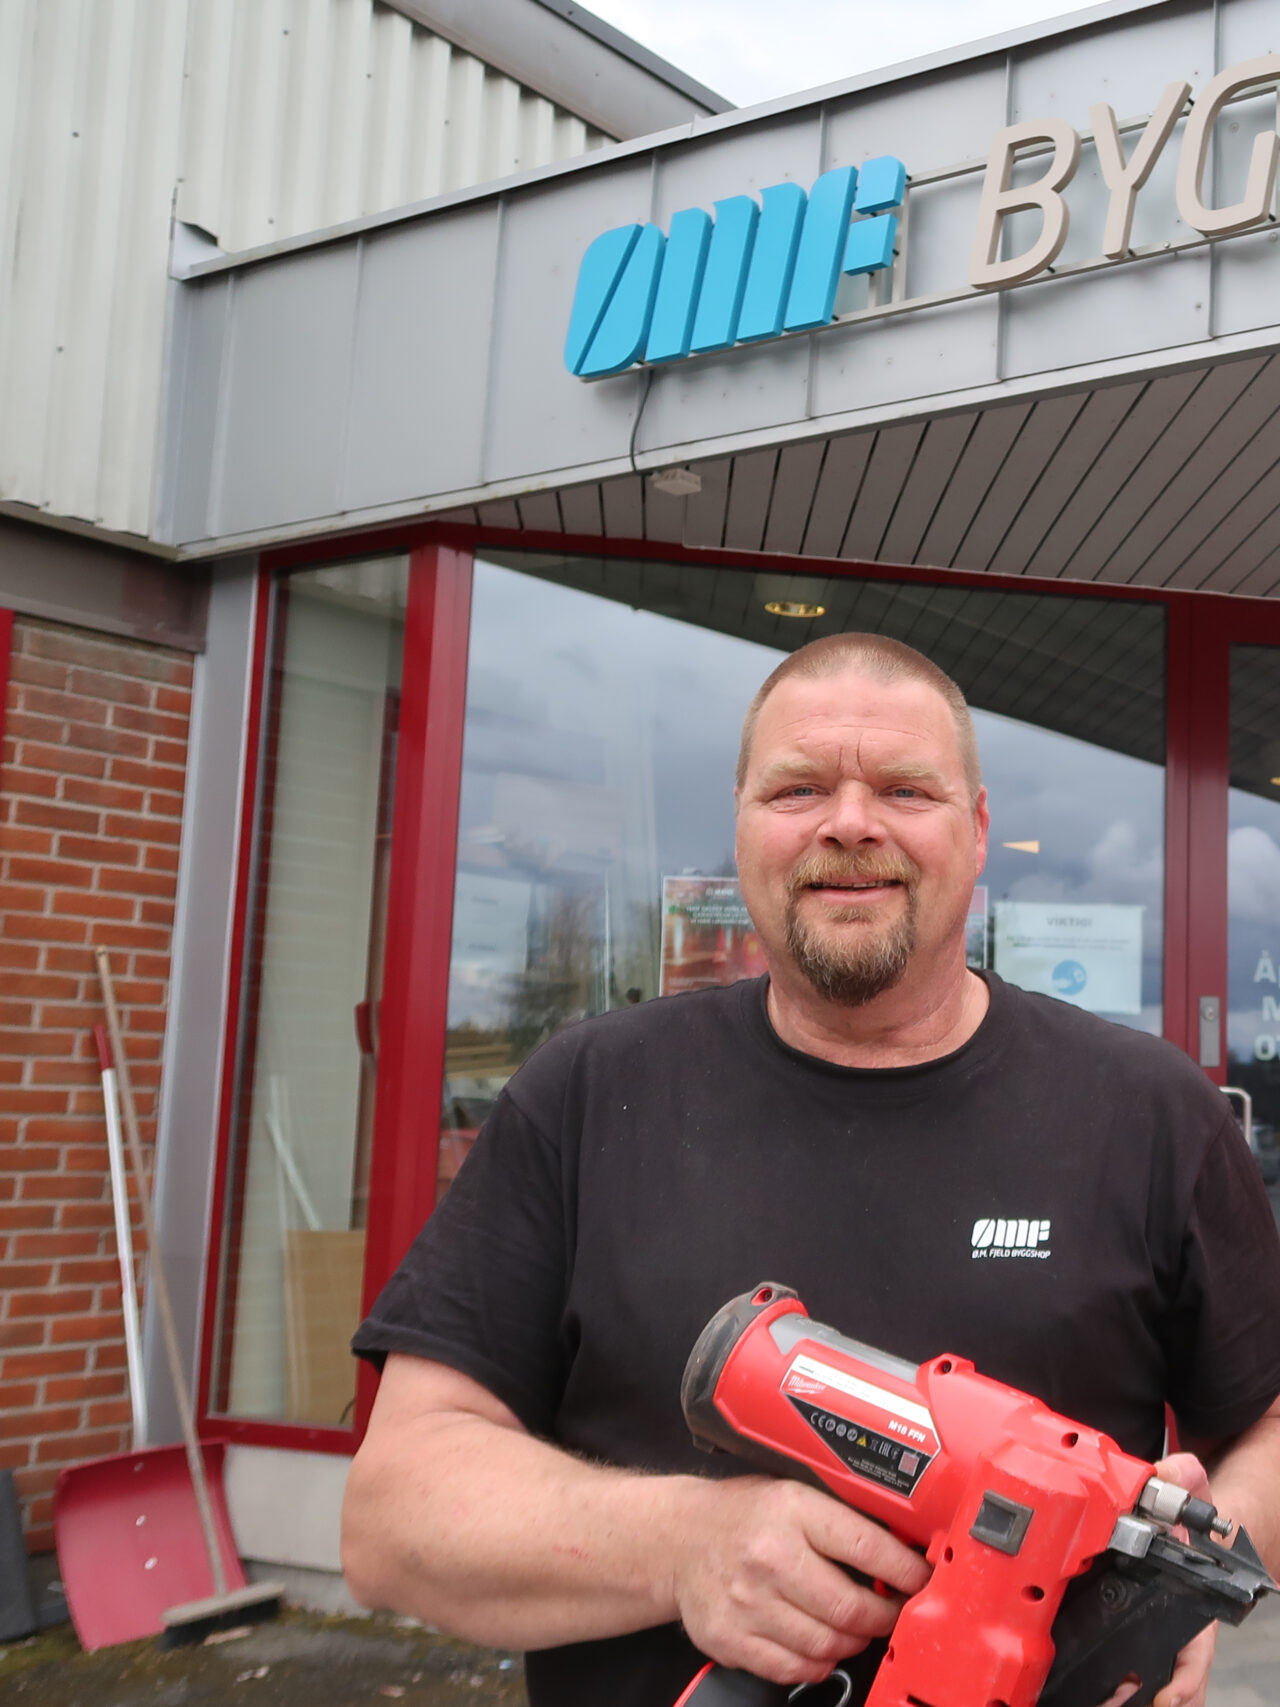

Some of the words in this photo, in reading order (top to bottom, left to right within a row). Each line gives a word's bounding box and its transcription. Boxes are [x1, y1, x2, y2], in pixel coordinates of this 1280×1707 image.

[989, 1248, 1010, 1258] FJELD
[1011, 1248, 1051, 1258] BYGGSHOP
[907, 1428, 926, 1443] FFN
